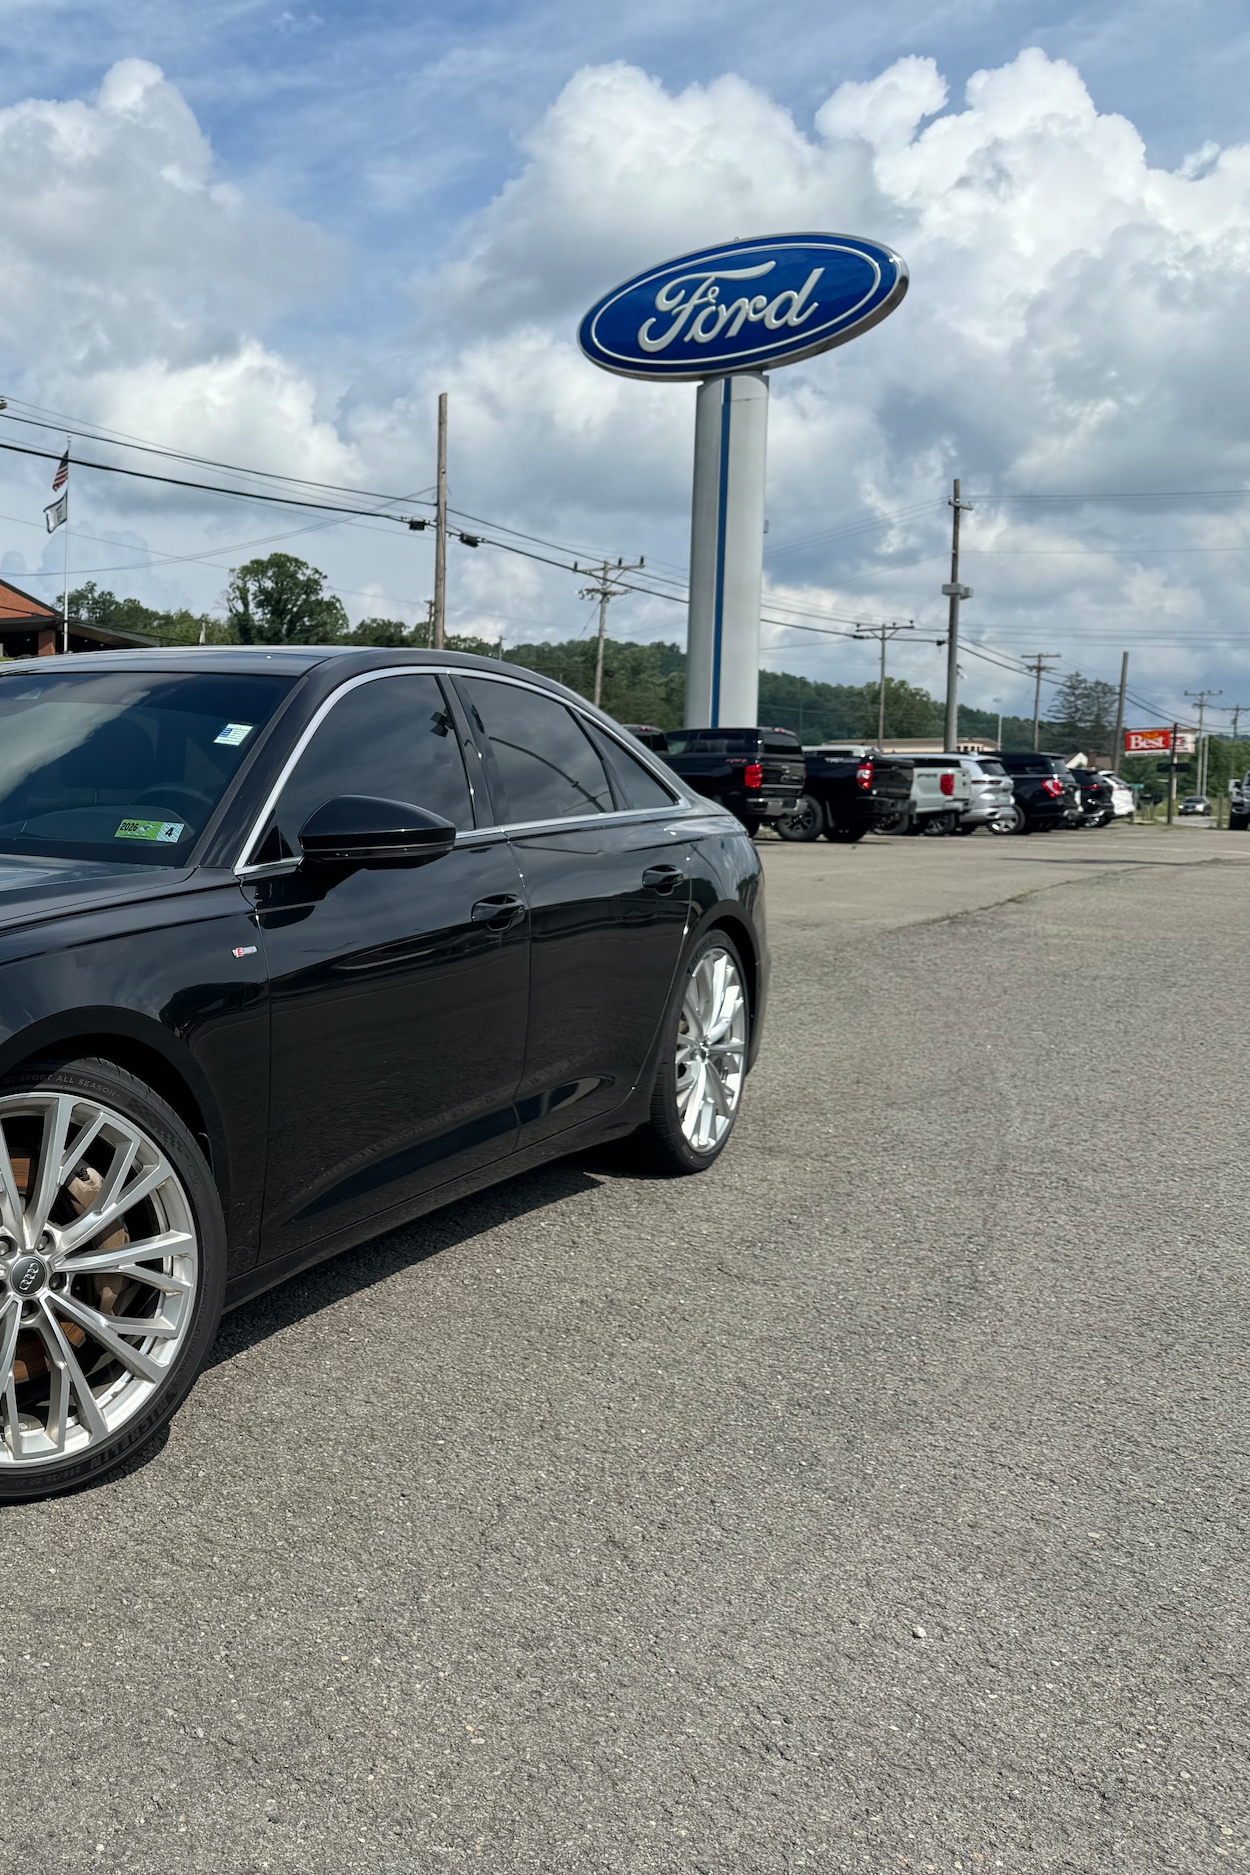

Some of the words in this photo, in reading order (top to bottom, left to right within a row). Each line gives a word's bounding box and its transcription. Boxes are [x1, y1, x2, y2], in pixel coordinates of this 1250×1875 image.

[637, 260, 826, 353] Ford
[1131, 734, 1165, 750] Best
[120, 822, 139, 832] 2026
[165, 827, 174, 837] 4
[19, 1073, 54, 1083] SPORT
[55, 1074, 75, 1085] ALL
[77, 1078, 117, 1097] SEASON
[89, 1399, 169, 1470] MICHELIN
